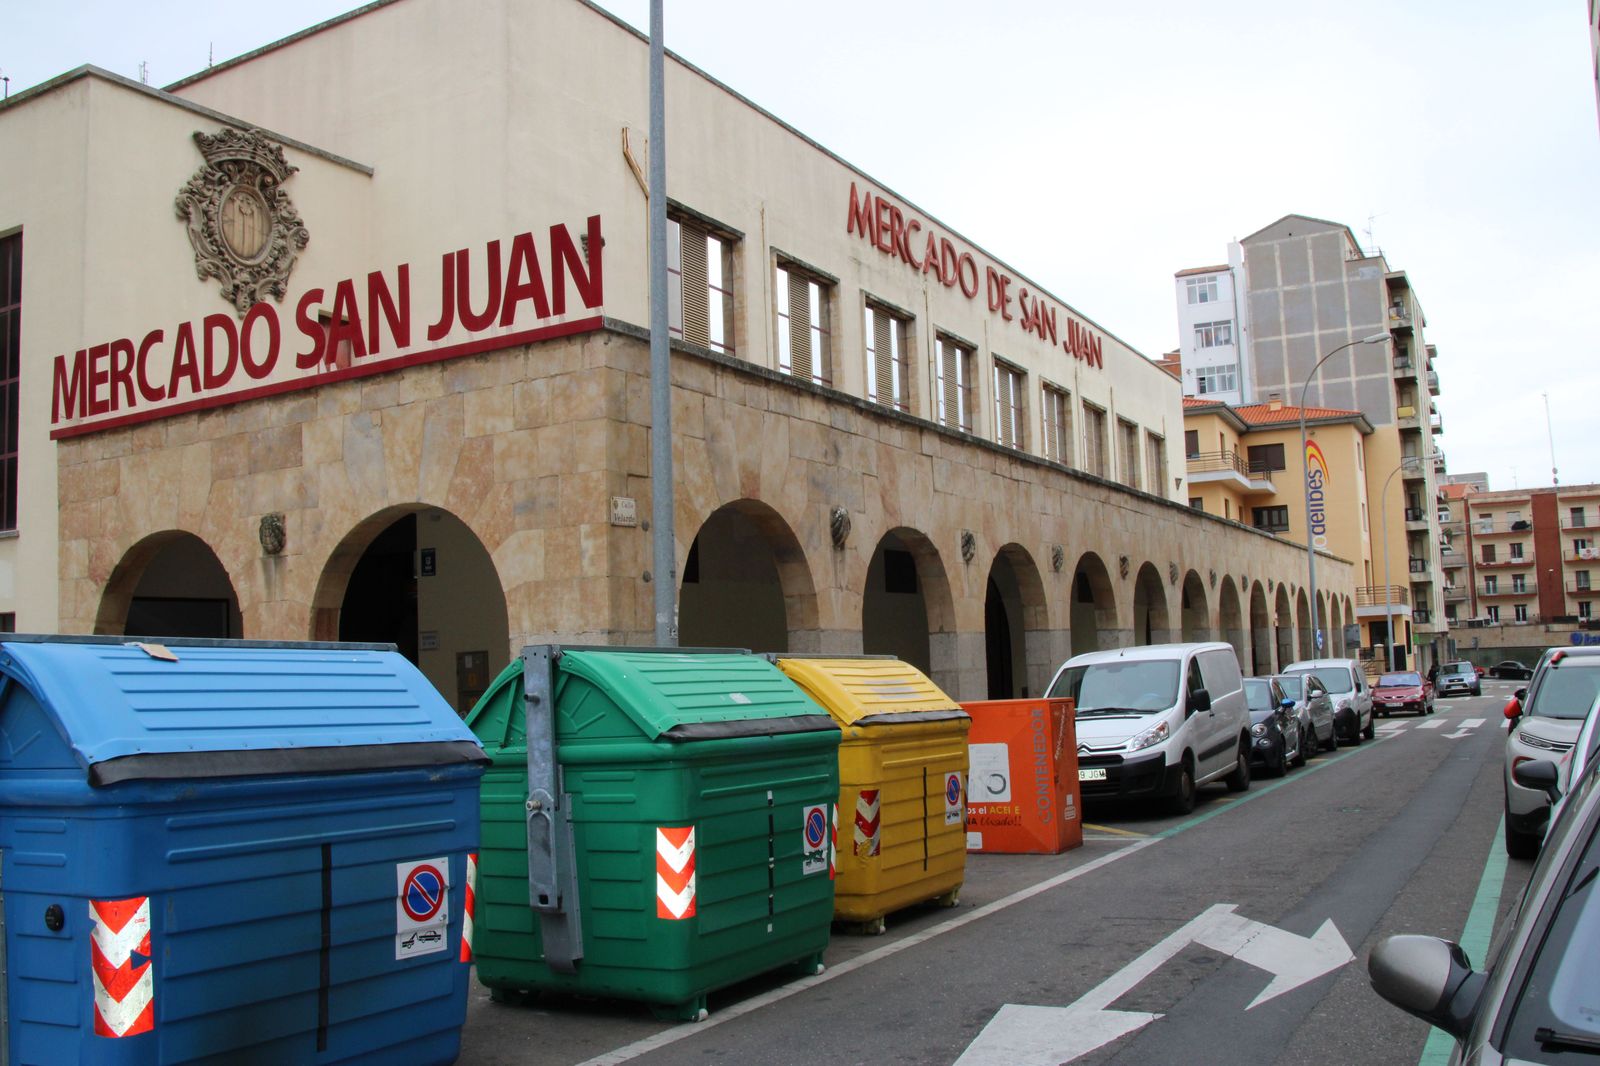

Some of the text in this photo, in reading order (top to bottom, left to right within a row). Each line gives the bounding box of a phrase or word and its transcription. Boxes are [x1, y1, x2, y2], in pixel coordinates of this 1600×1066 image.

[51, 214, 603, 424] MERCADO SAN JUAN
[847, 182, 1103, 370] MERCADO DE SAN JUAN
[1032, 709, 1052, 824] CONTENEDOR
